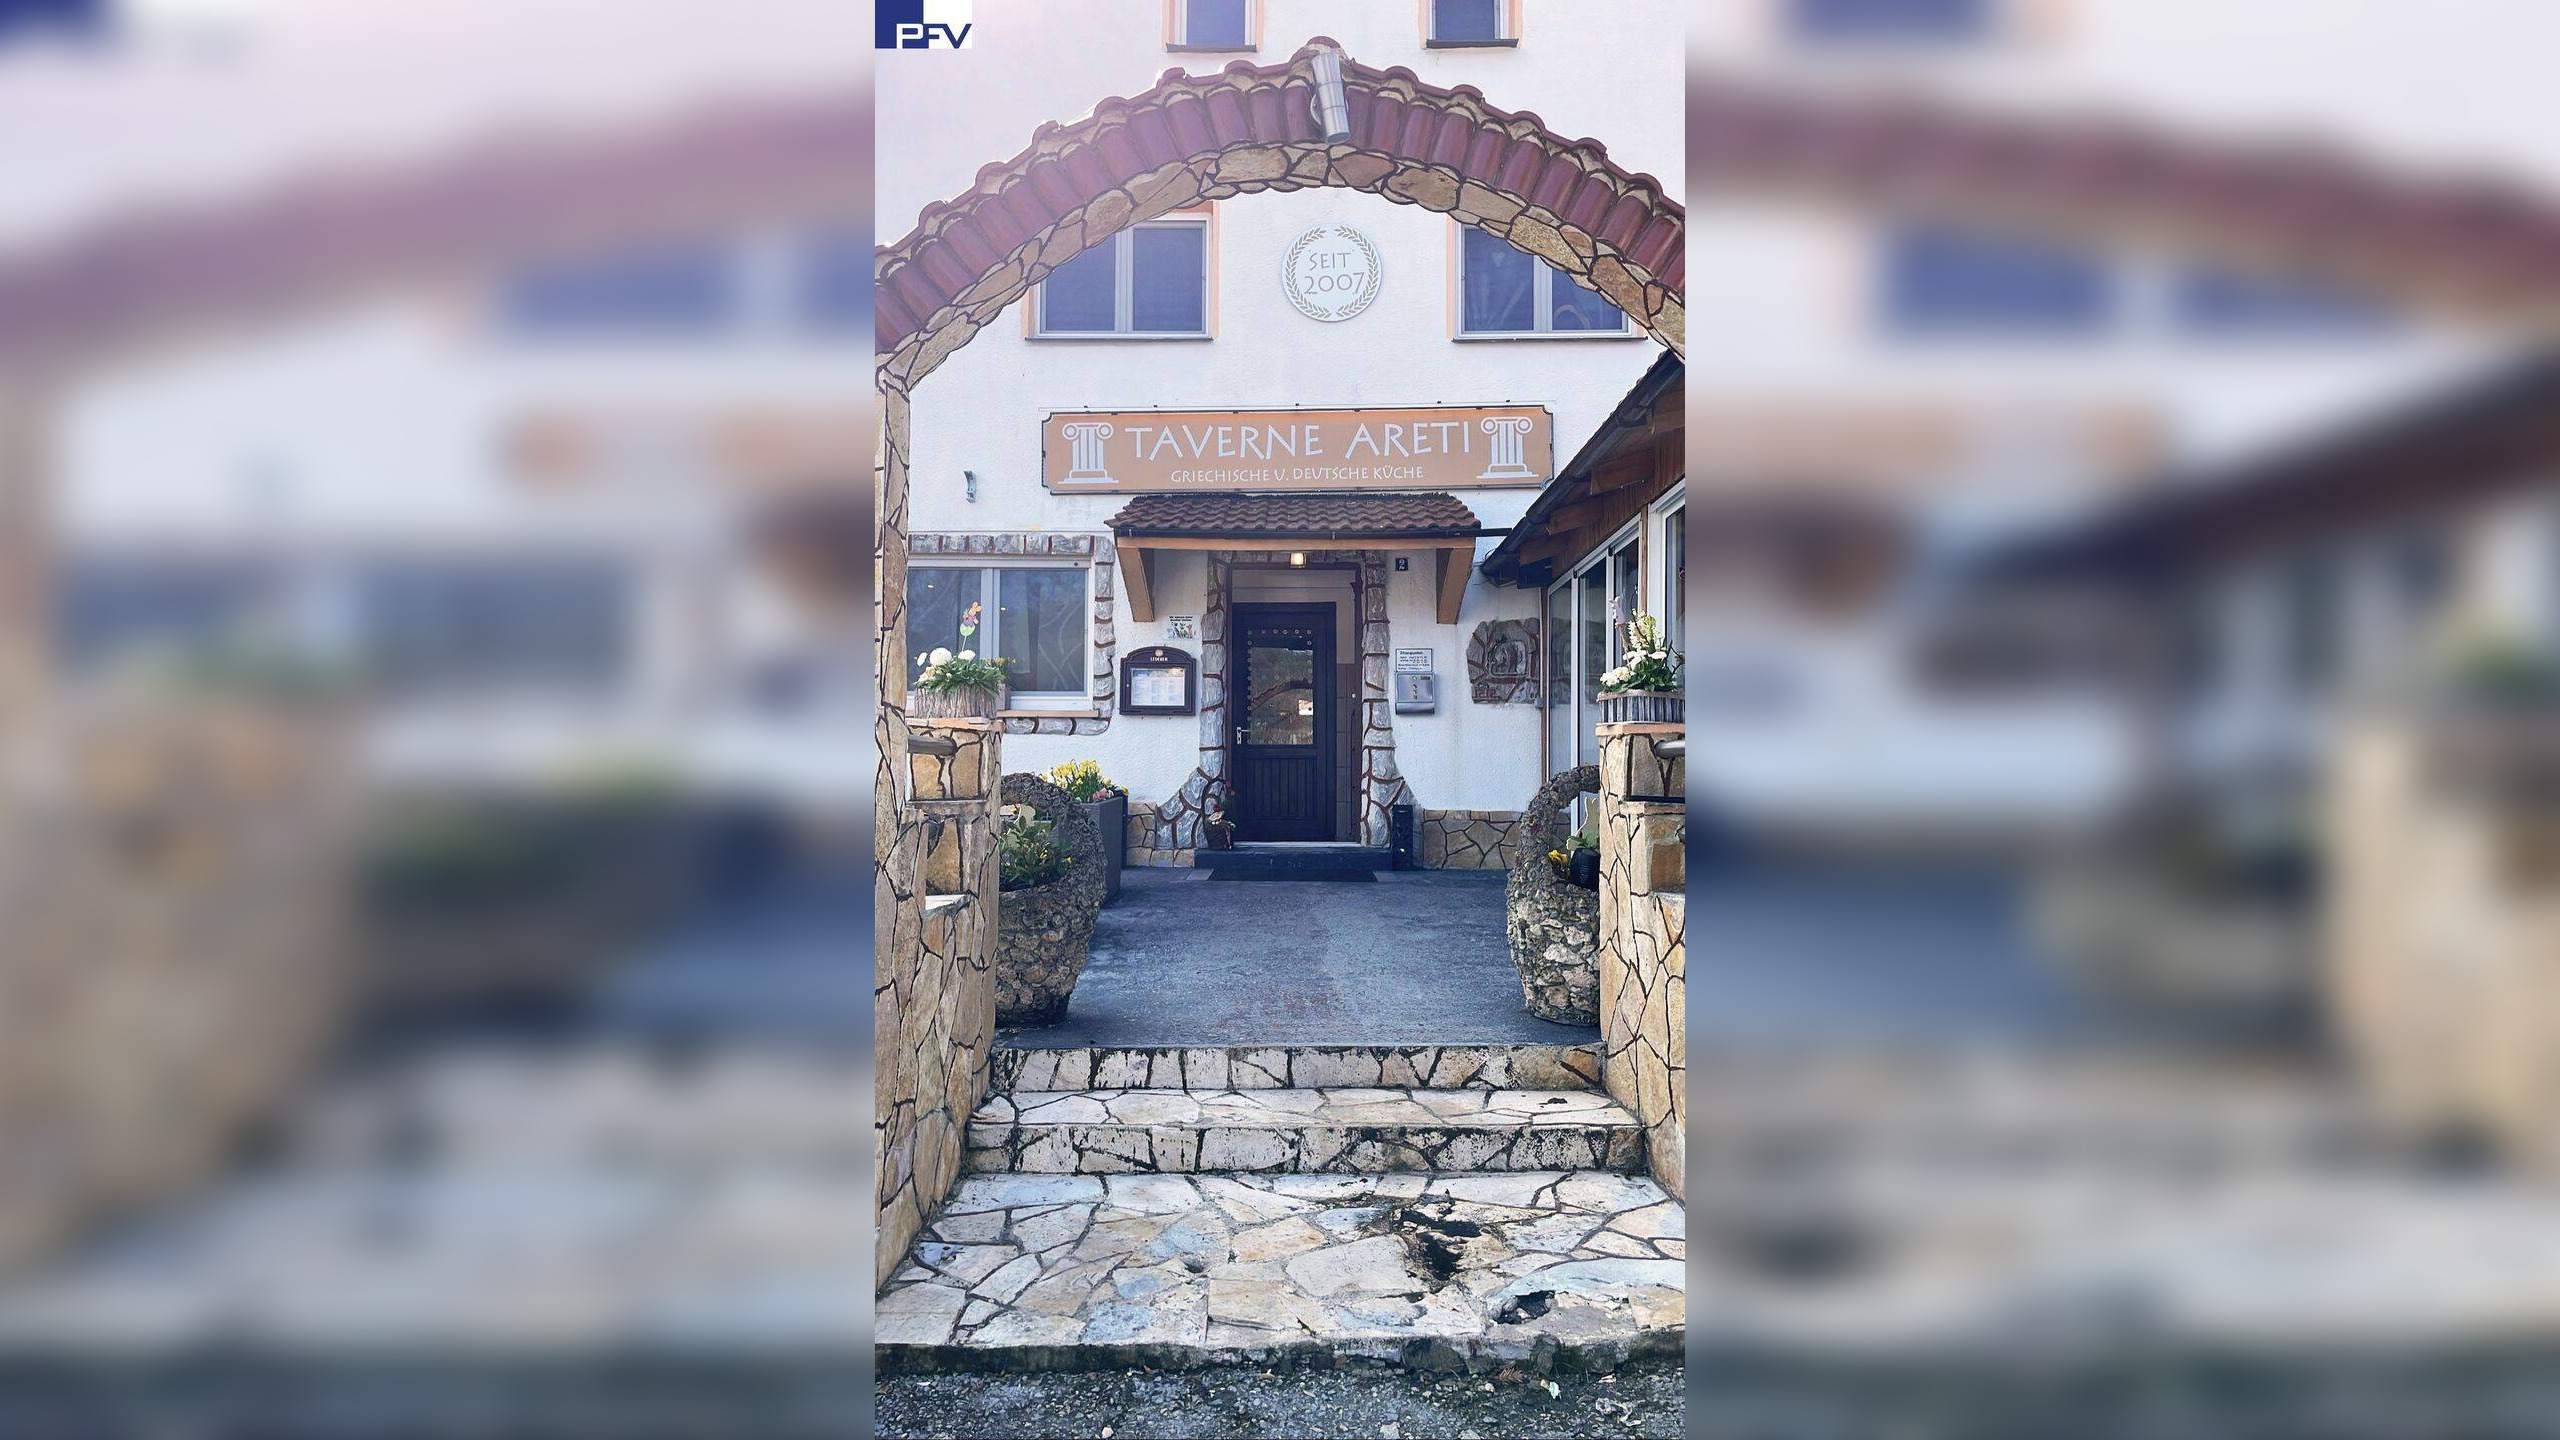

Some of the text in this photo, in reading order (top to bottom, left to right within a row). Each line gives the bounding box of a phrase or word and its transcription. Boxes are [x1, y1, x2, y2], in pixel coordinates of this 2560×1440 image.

[1308, 252, 1352, 271] SEIT
[1303, 271, 1365, 295] 2007
[1124, 421, 1470, 462] TAVERNE ARETI
[1171, 468, 1269, 484] GRIECHISCHE
[1293, 466, 1369, 481] DEUTSCHE
[1373, 464, 1424, 480] KÜCHE
[1398, 559, 1406, 570] 2
